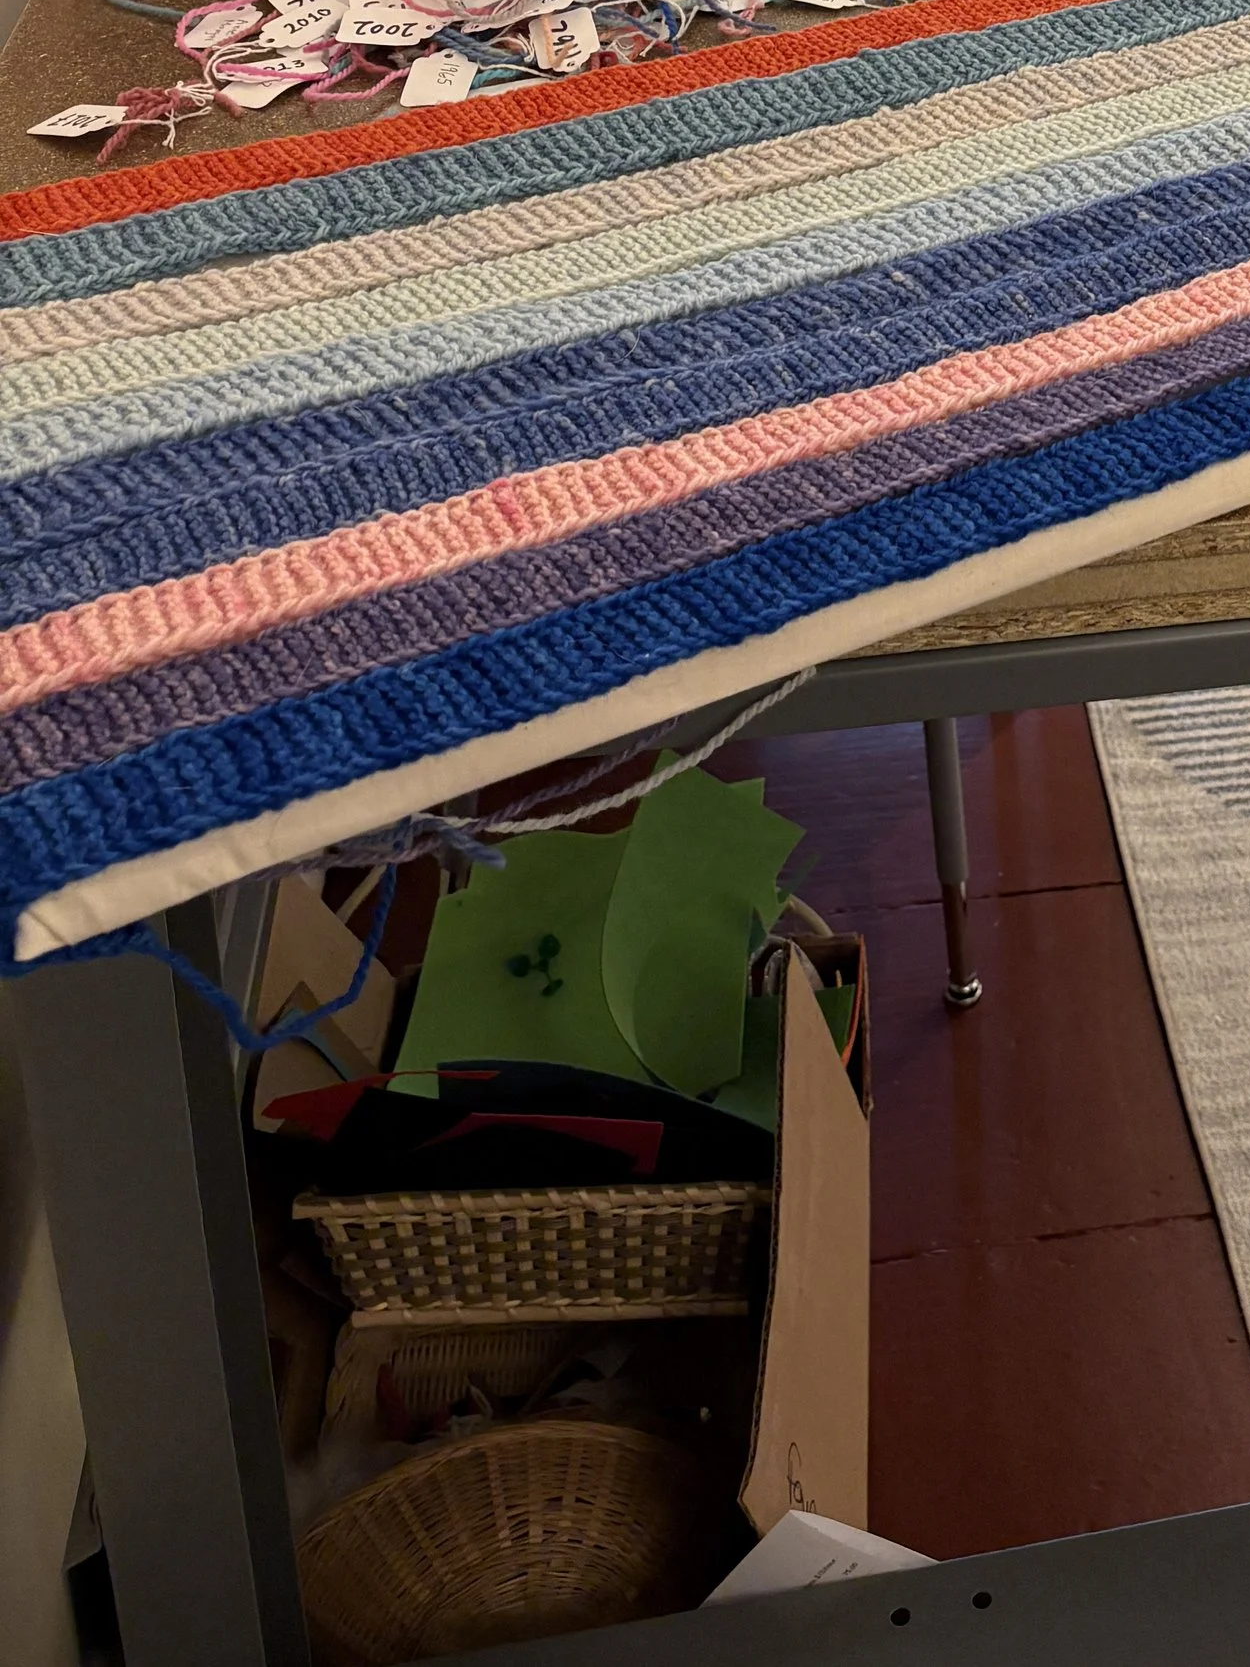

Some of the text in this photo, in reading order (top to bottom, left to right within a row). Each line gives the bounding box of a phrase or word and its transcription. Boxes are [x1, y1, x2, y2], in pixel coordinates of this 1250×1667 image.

[283, 8, 332, 35] 2010
[353, 20, 419, 38] 2002
[436, 61, 461, 87] 1965
